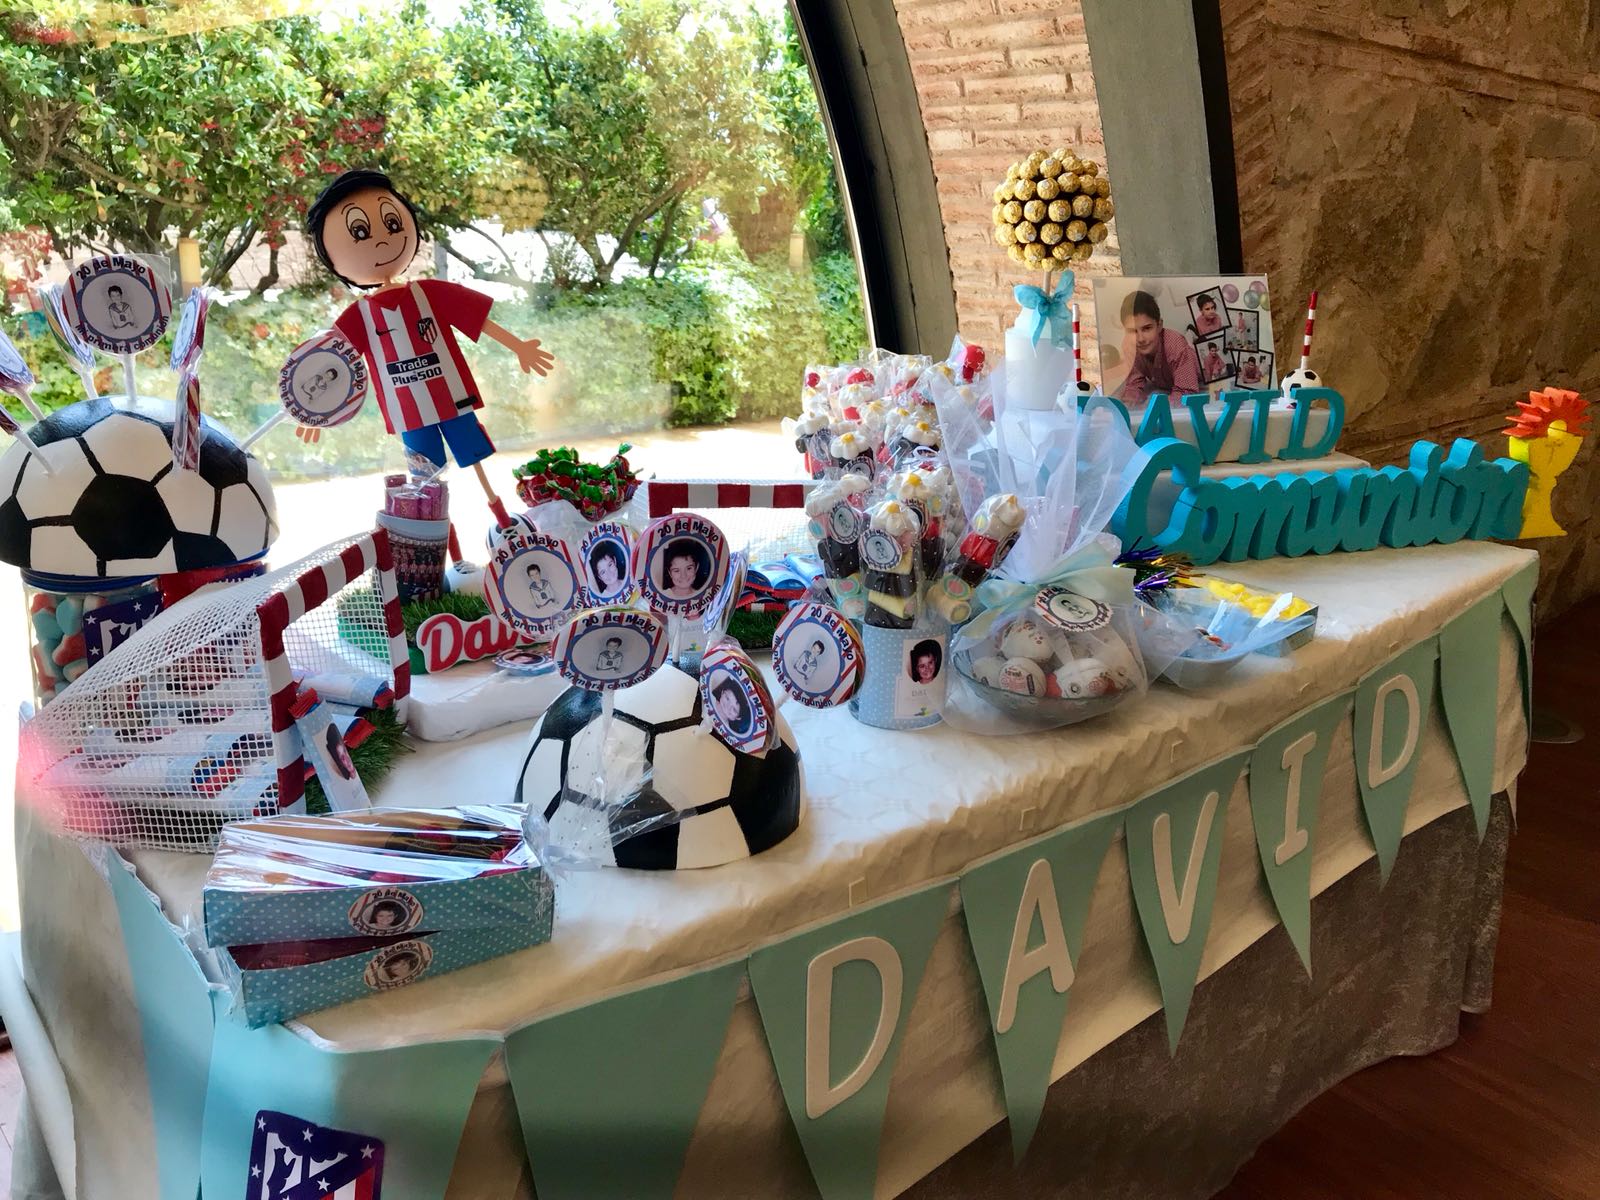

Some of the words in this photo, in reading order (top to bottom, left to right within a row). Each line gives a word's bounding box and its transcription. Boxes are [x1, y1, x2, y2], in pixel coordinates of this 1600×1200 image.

[76, 266, 91, 280] 20
[93, 259, 108, 272] de
[112, 257, 146, 276] Mayo
[391, 367, 443, 386] Plus500
[396, 358, 429, 372] Trade
[1112, 437, 1530, 566] Comunión
[658, 525, 672, 537] 20
[675, 520, 688, 531] de
[692, 521, 719, 542] Mayo
[495, 550, 509, 565] 20
[509, 540, 524, 555] de
[526, 533, 559, 550] Mayo
[582, 615, 599, 628] 20
[606, 612, 620, 622] de
[626, 613, 657, 632] Mayo
[811, 606, 822, 618] 20
[823, 612, 837, 628] de
[836, 627, 854, 661] Mayo
[806, 674, 1420, 1120] DAVID
